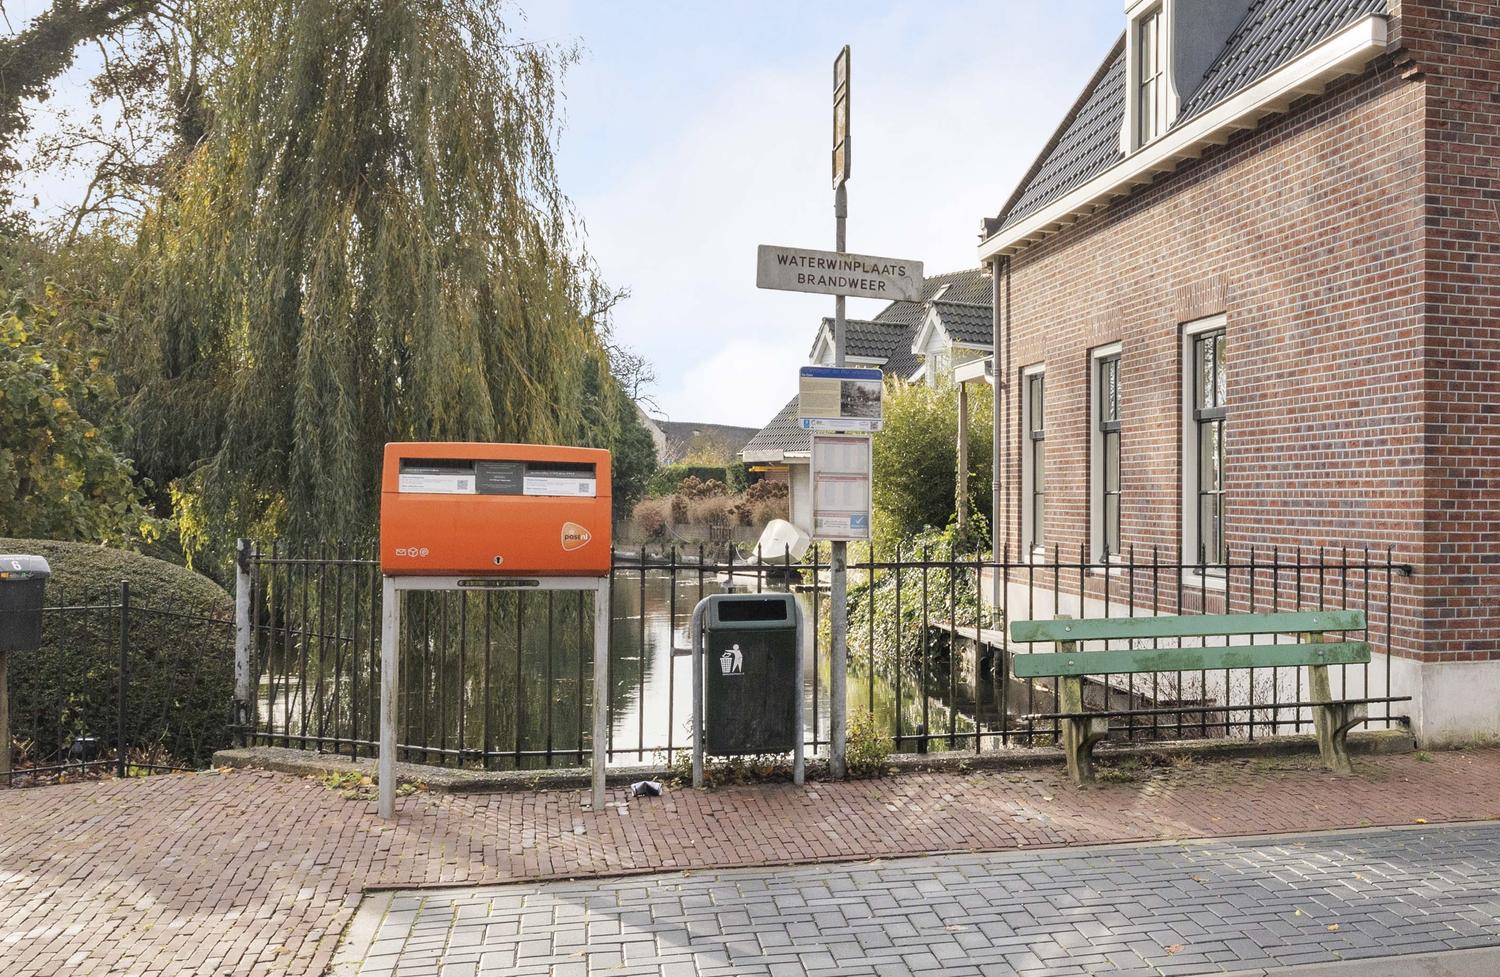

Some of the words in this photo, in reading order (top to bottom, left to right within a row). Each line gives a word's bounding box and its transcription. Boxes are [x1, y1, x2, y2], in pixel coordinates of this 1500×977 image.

[777, 254, 906, 277] WATERWINPLAATS
[797, 273, 886, 292] BRANDWEER
[11, 560, 22, 571] 6
